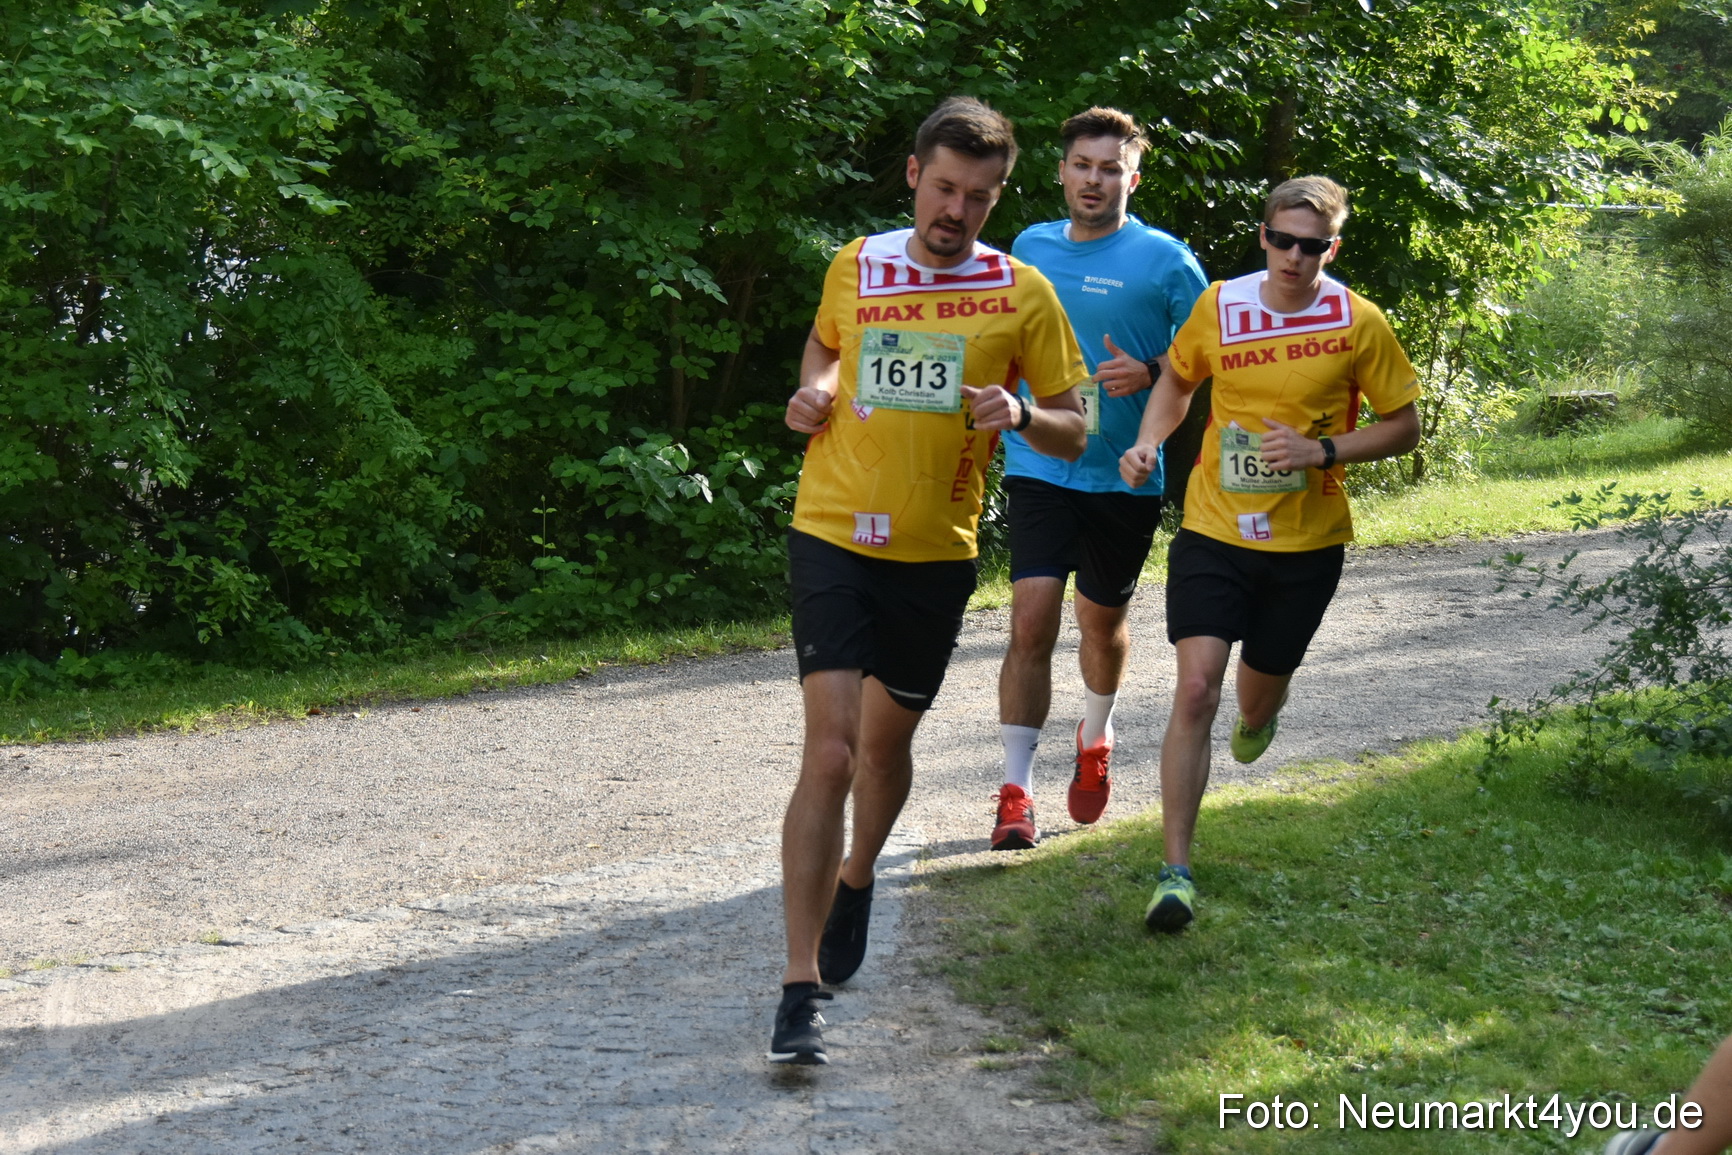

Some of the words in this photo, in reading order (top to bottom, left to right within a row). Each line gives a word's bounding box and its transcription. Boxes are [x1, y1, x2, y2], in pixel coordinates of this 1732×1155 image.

[1081, 285, 1108, 295] Dominik
[856, 303, 925, 324] MAX
[936, 296, 1017, 319] BÖGL
[1220, 347, 1278, 370] MAX
[1286, 336, 1353, 360] BÖGL
[870, 357, 947, 390] 1613
[878, 387, 897, 395] Kolb
[899, 388, 935, 398] Christian
